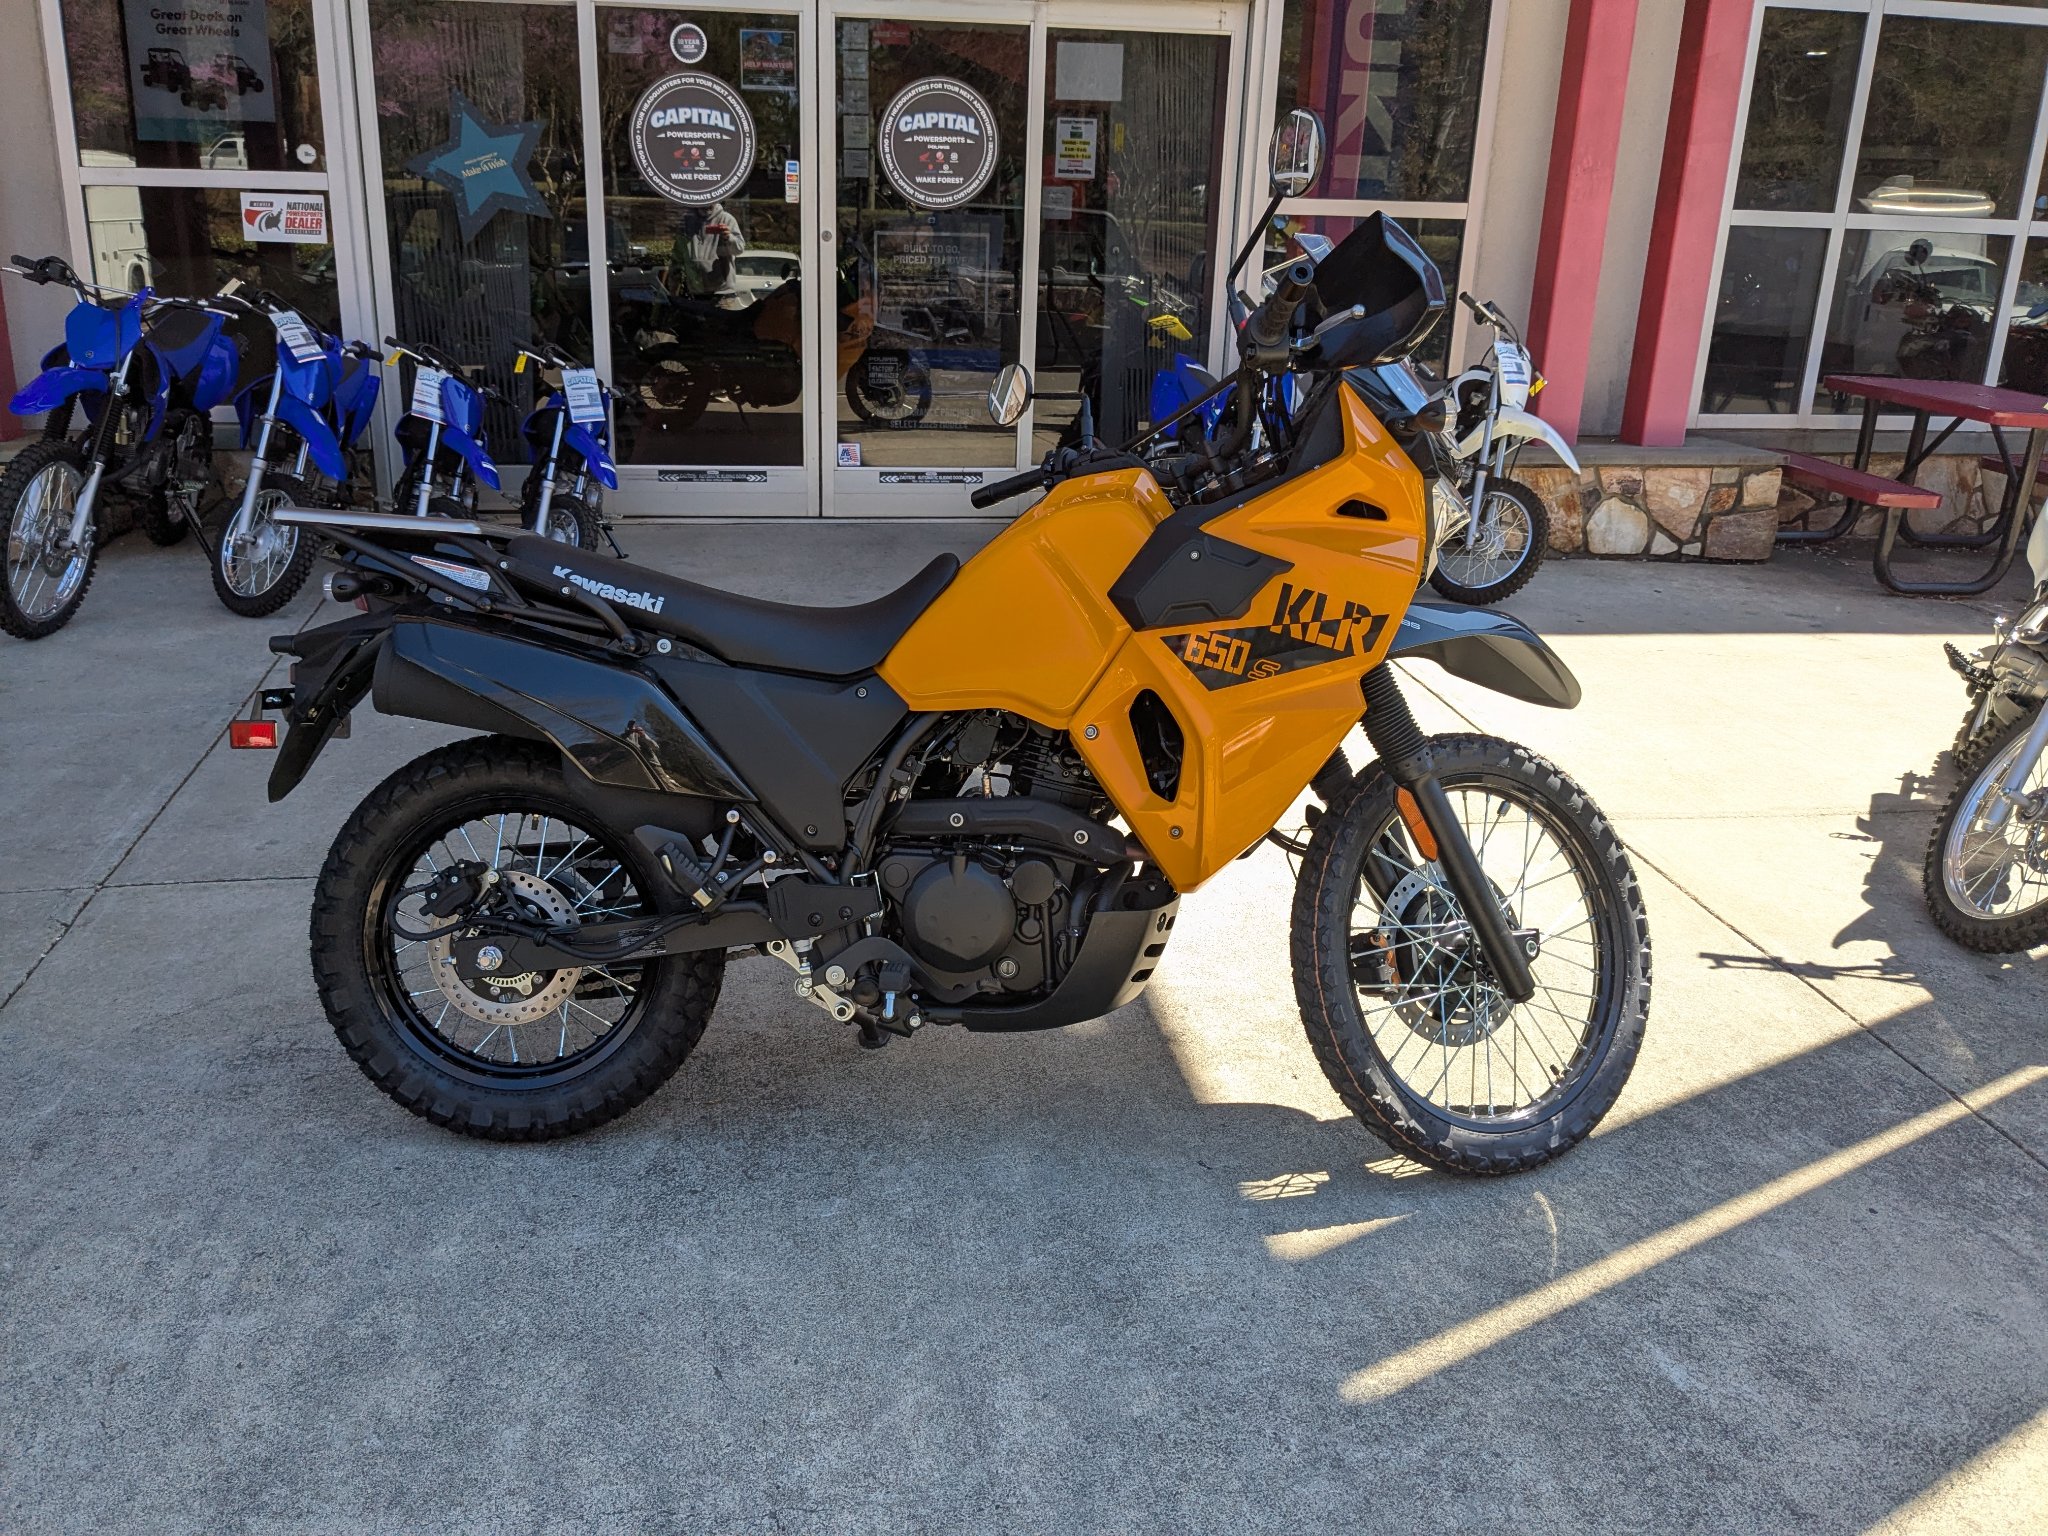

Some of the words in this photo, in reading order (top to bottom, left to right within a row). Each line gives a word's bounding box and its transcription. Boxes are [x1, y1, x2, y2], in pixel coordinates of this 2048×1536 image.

[150, 8, 187, 20] Great
[190, 9, 224, 22] Deals
[226, 13, 243, 23] on
[155, 23, 192, 35] Great
[195, 25, 240, 38] Wheels
[743, 61, 759, 69] HELP
[1334, 0, 1406, 180] UKI
[635, 111, 646, 129] YOUR
[643, 78, 681, 113] HEADQUARTERS
[695, 77, 713, 87] YOUR
[713, 82, 729, 97] NEXT
[884, 116, 895, 133] YOUR
[892, 84, 930, 118] HEADQUARTERS
[943, 83, 960, 93] YOUR
[960, 88, 974, 102] NEXT
[650, 107, 736, 131] CAPITAL
[899, 112, 980, 135] CAPITAL
[635, 135, 643, 150] OUR
[666, 131, 722, 139] POWERSPORTS
[913, 135, 966, 143] POWERSPORTS
[638, 150, 649, 169] GOAL
[646, 166, 655, 176] TO
[693, 173, 722, 181] FOREST
[885, 153, 895, 173] GOAL
[891, 170, 900, 180] TO
[897, 178, 915, 196] OFFER
[914, 192, 926, 201] THE
[925, 195, 954, 204] ULTIMATE
[953, 179, 981, 201] CUSTOMER
[652, 174, 671, 192] OFFER
[711, 175, 741, 198] CUSTOMER
[915, 176, 936, 184] WAKE
[670, 188, 682, 198] THE
[681, 193, 712, 201] ULTIMATE
[286, 201, 324, 211] NATIONAL
[285, 216, 322, 229] DEALER
[903, 243, 929, 253] BUILT
[931, 245, 943, 253] TO
[893, 255, 927, 264] PRICED
[928, 256, 940, 265] TO
[890, 420, 917, 429] SELECT
[1269, 582, 1374, 656] KLR
[1183, 631, 1252, 676] 650
[1248, 658, 1282, 680] S
